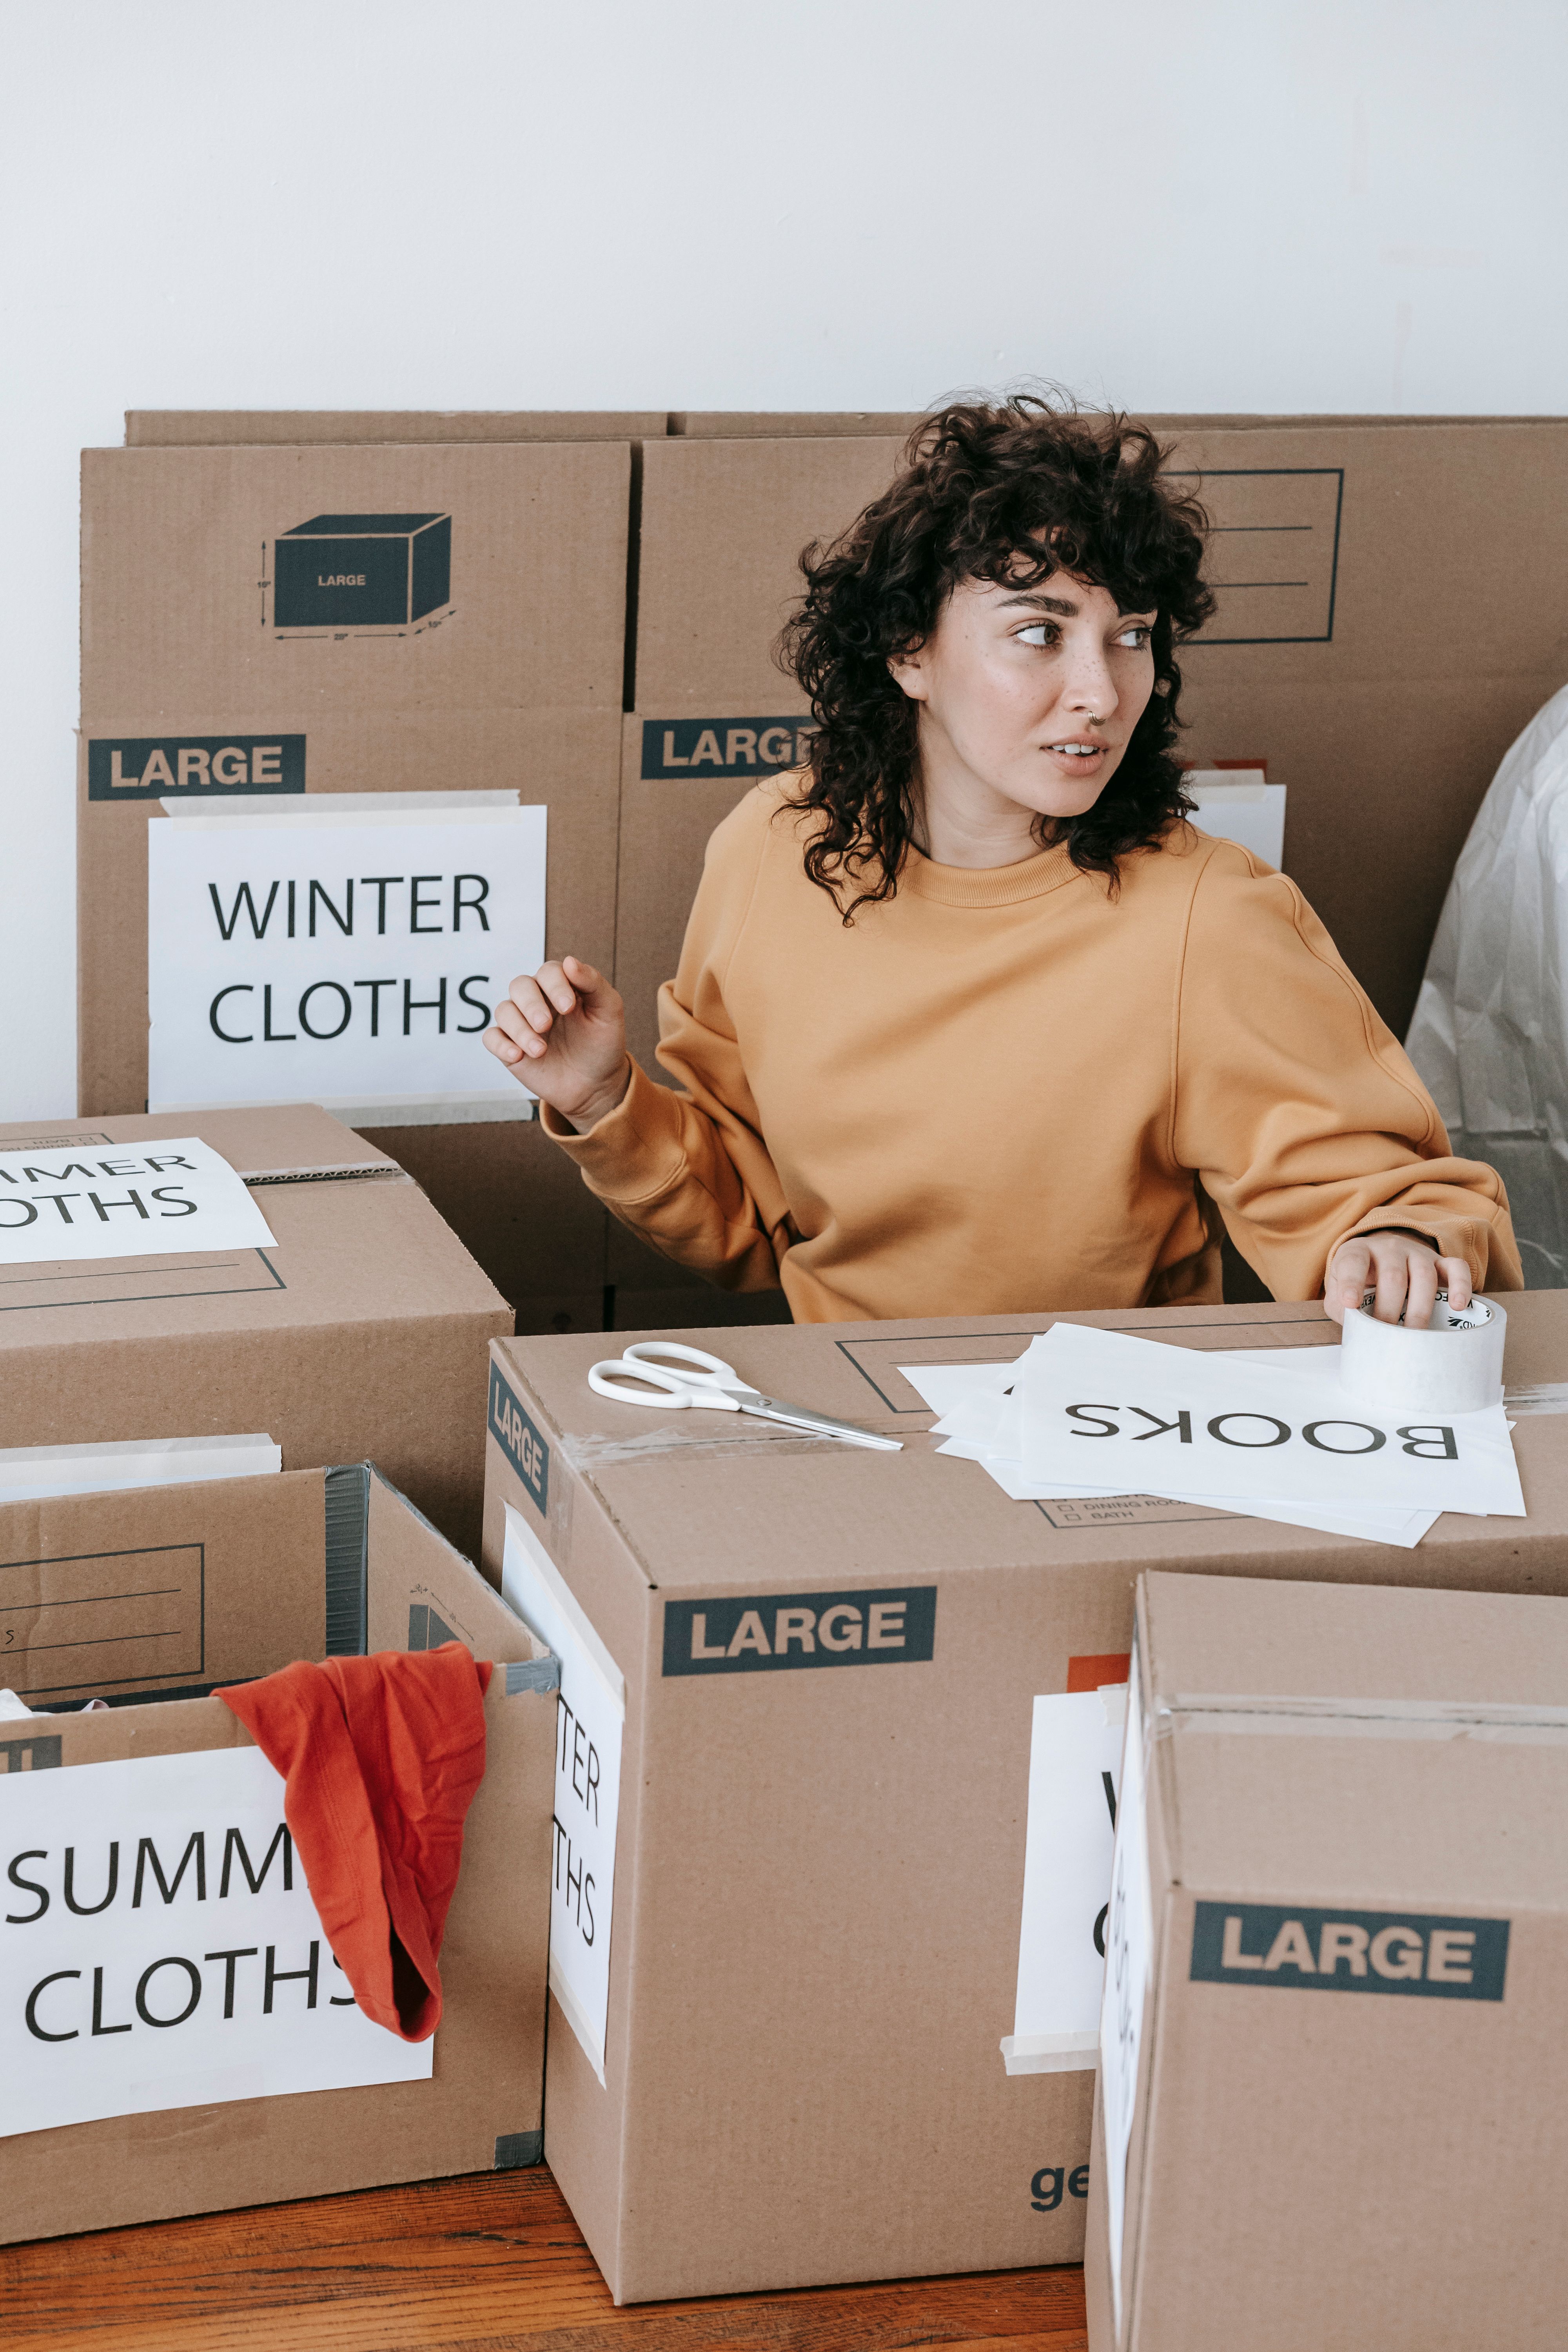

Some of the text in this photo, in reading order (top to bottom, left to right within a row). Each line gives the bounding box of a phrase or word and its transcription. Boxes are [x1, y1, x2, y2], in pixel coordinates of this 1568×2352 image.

[318, 573, 367, 586] LARGE
[111, 746, 282, 788] LARGE
[209, 874, 490, 940] WINTER
[209, 975, 491, 1043] CLOTHS
[494, 1381, 543, 1493] LARGE
[1065, 1403, 1459, 1460] BOOKS
[1083, 1501, 1142, 1510] DINING
[691, 1602, 907, 1660] LARGE
[5, 1822, 293, 1924] SUMM
[1221, 1916, 1477, 1984] LARGE
[1031, 2164, 1090, 2213] ge
